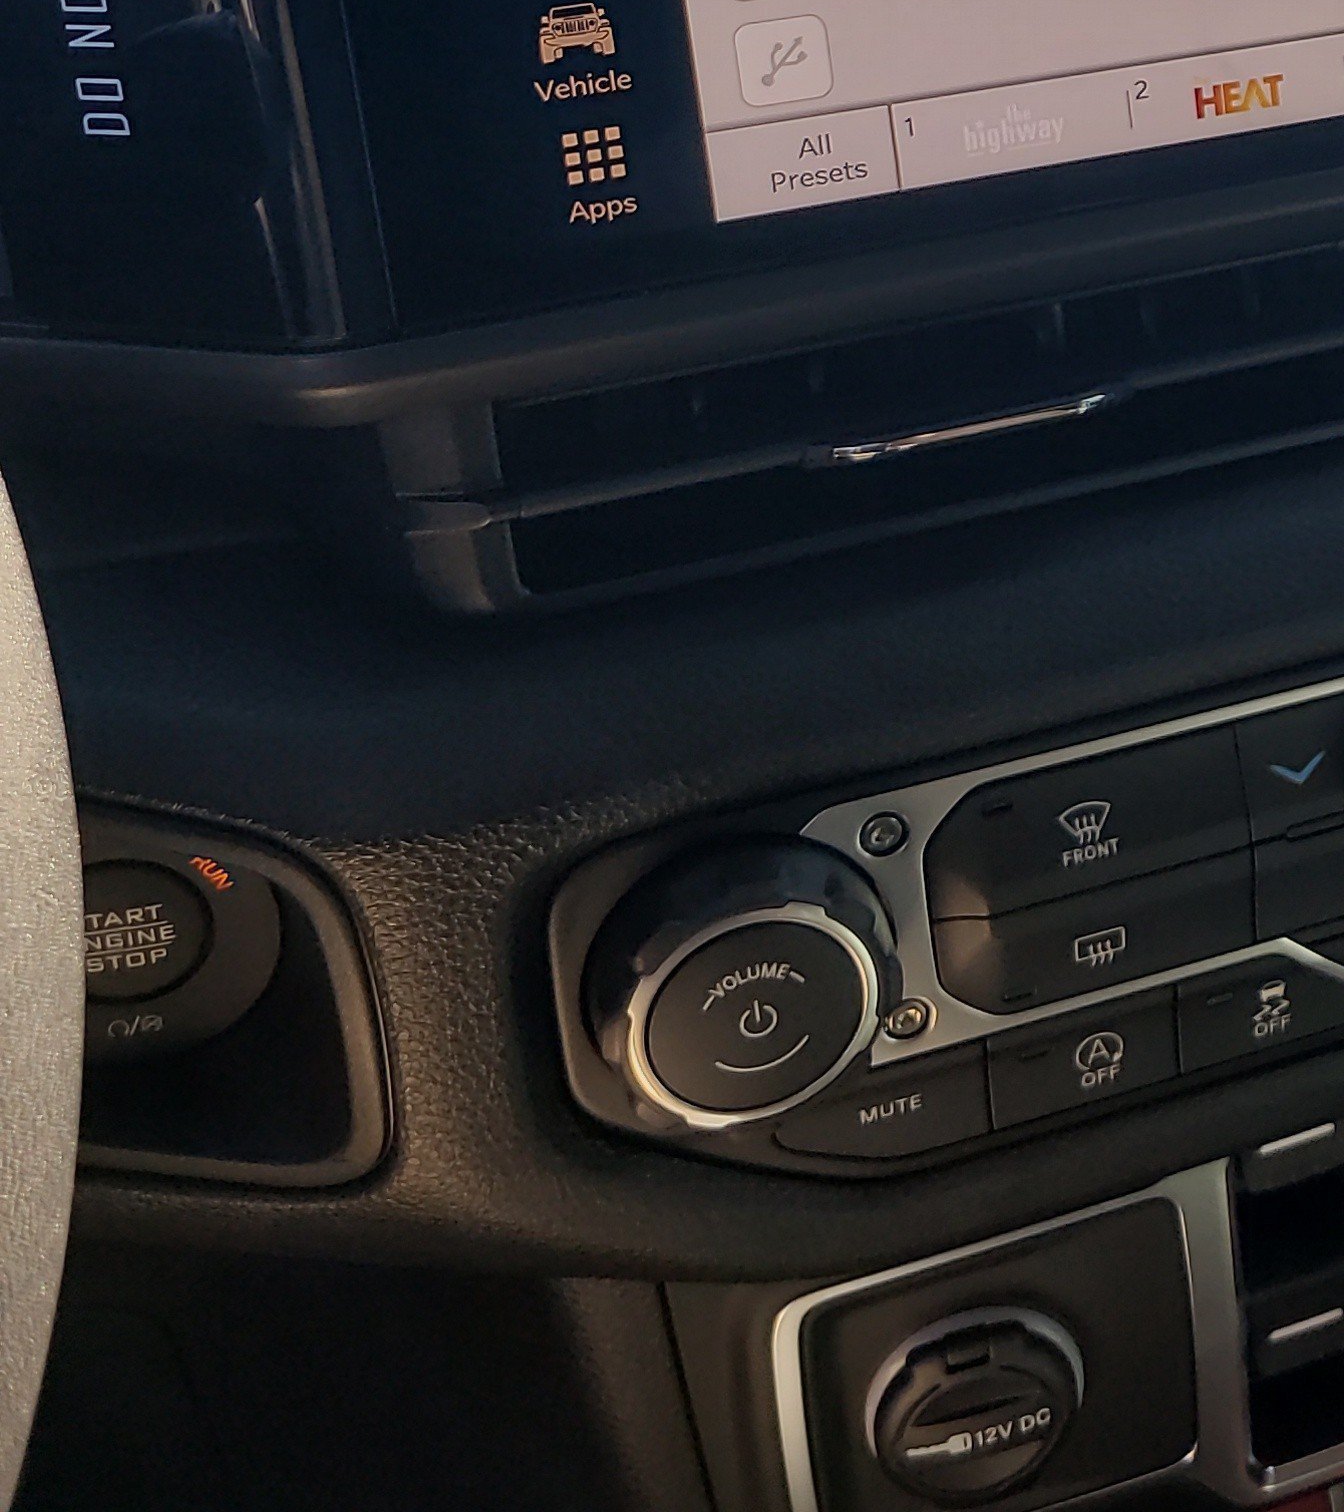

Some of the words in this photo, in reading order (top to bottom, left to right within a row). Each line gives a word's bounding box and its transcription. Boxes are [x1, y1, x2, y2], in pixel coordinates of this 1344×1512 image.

[534, 68, 633, 101] Vehicle
[1134, 80, 1149, 100] 2
[1194, 74, 1283, 119] HEAT
[75, 78, 131, 138] DO
[904, 116, 916, 137] 1
[962, 115, 1064, 155] highway
[797, 134, 832, 159] All
[770, 158, 869, 194] Presets
[568, 194, 638, 225] Apps
[1062, 837, 1119, 867] FRONT
[188, 857, 234, 890] RUN
[85, 904, 163, 929] TART
[85, 924, 176, 952] NGINE
[86, 948, 168, 973] STOP
[708, 962, 790, 998] VOLUME
[1254, 1015, 1290, 1037] OFF
[1081, 1065, 1121, 1086] OFF
[859, 1094, 922, 1124] MUTE
[975, 1420, 1012, 1447] 12V
[1020, 1407, 1050, 1434] DC
